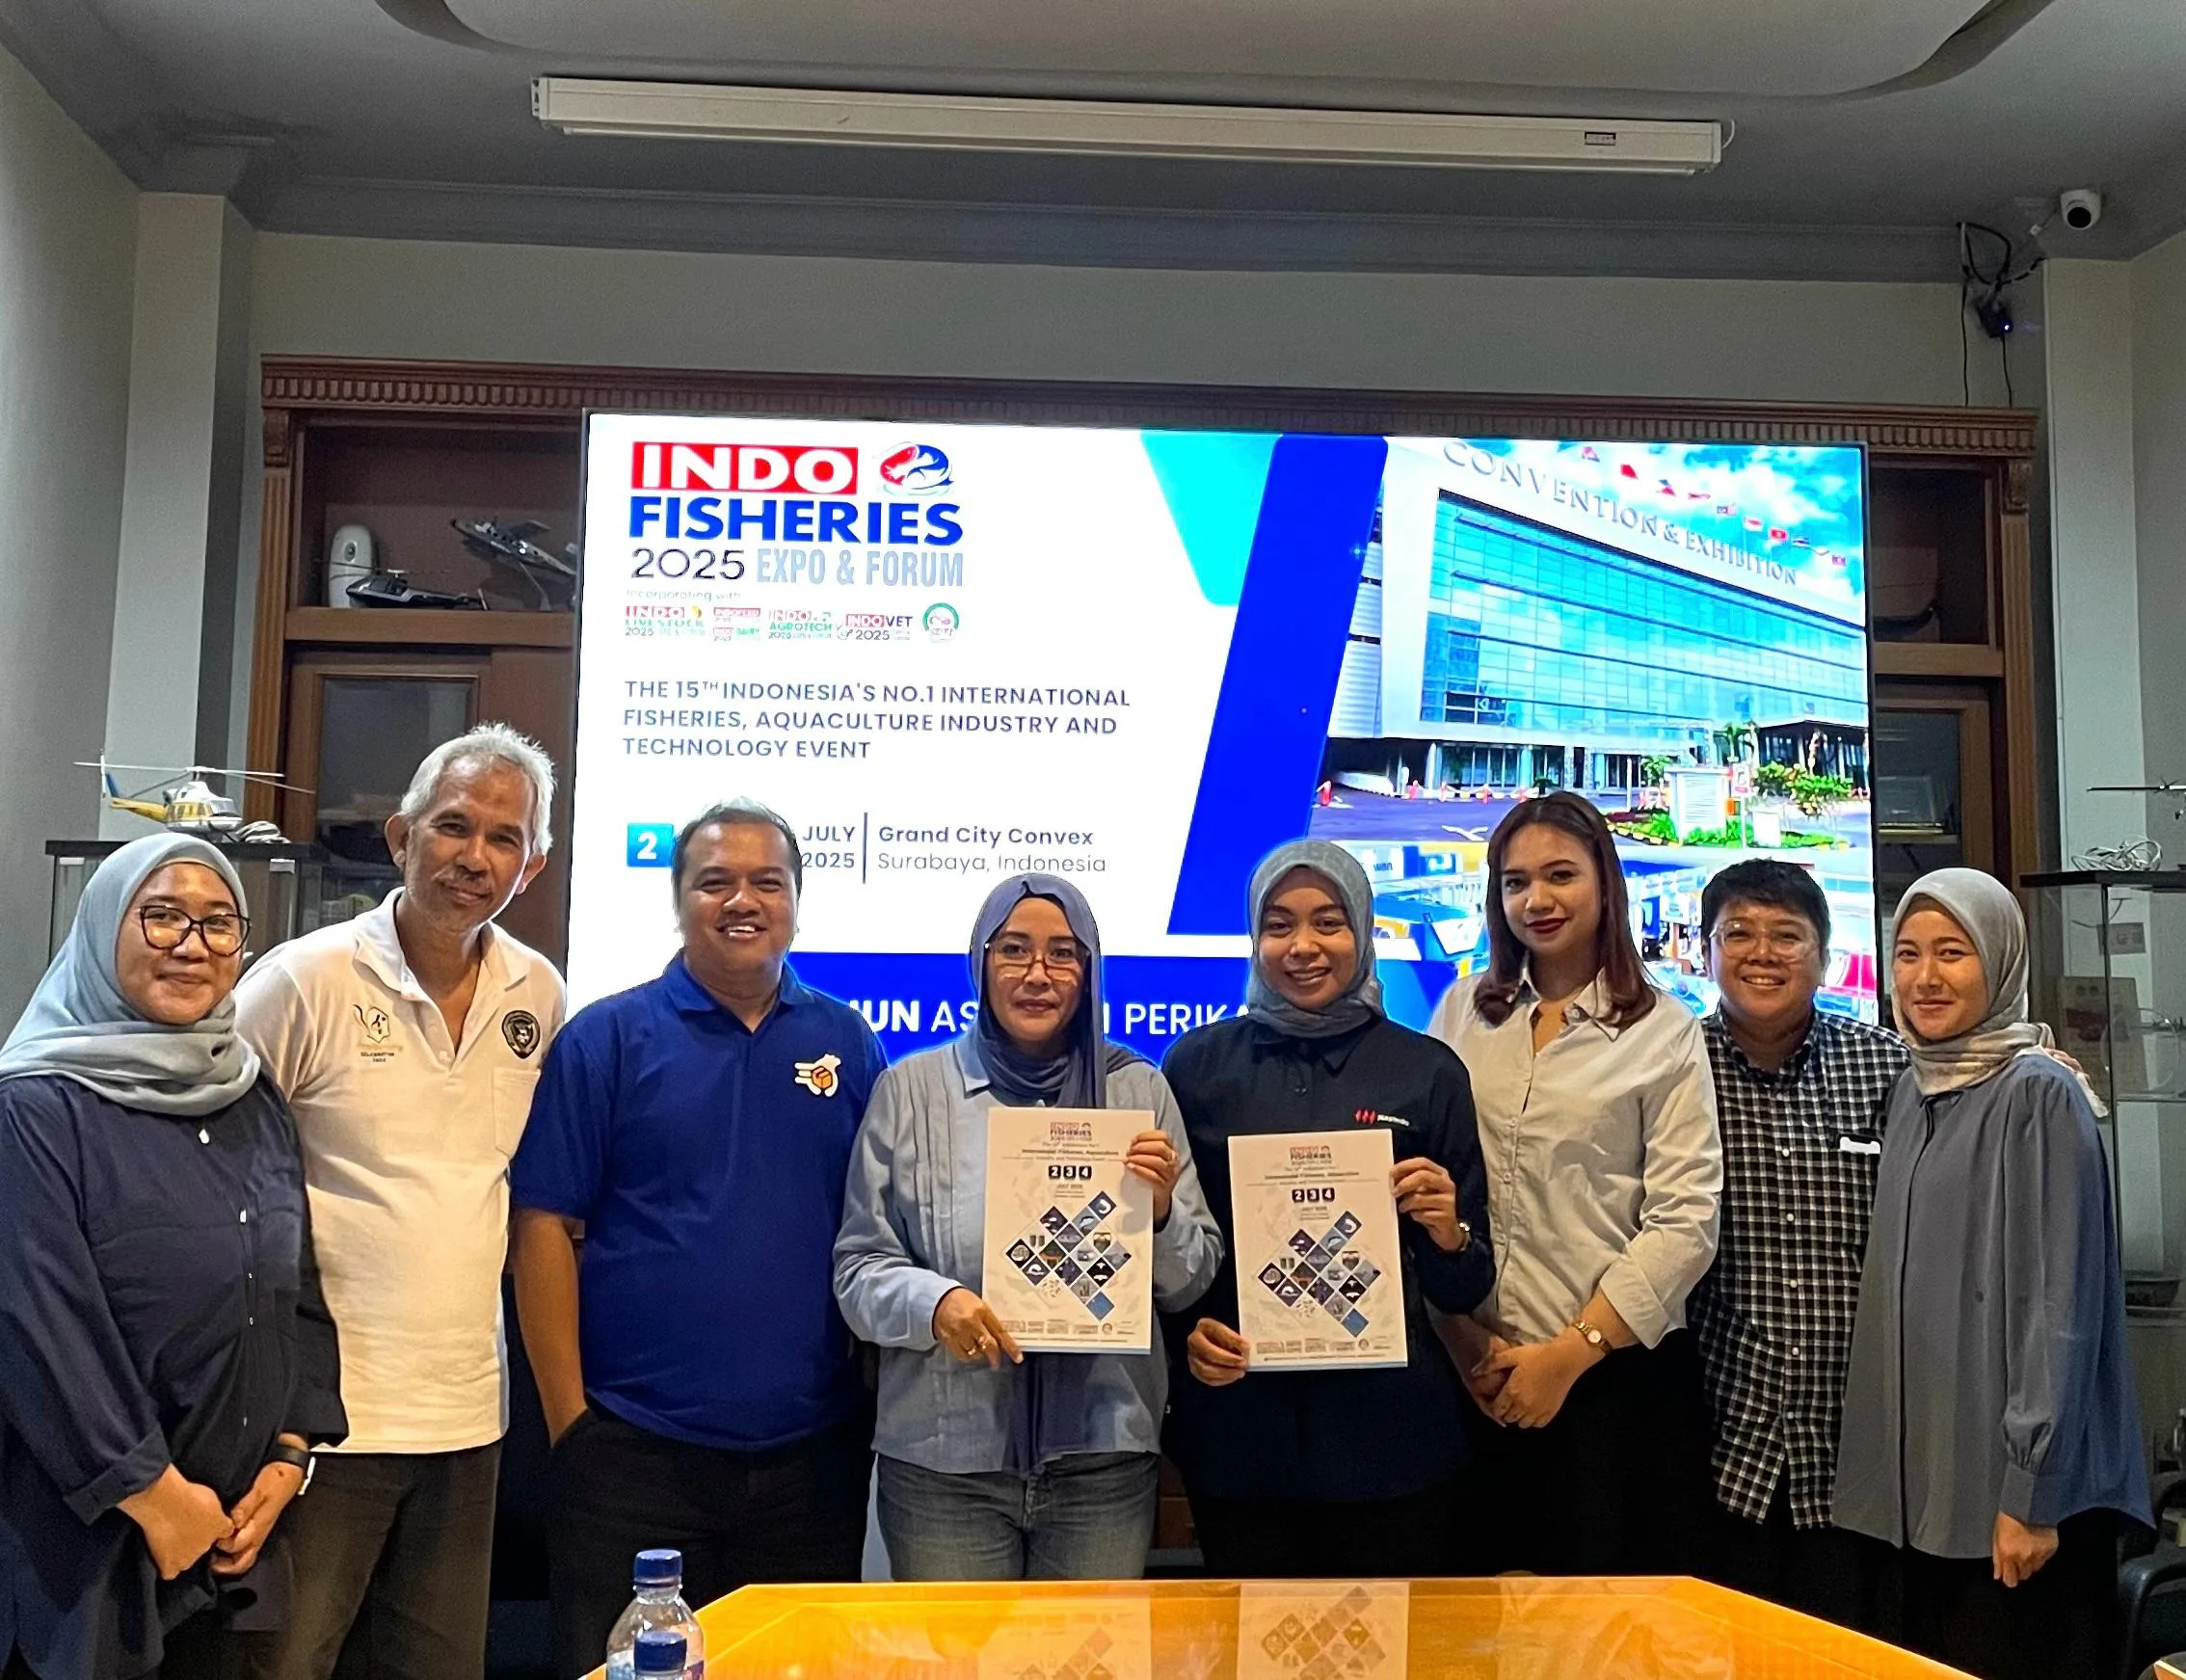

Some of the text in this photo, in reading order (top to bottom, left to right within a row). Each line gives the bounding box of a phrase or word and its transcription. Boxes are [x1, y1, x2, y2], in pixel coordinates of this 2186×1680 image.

[642, 444, 854, 494] INDO
[628, 495, 964, 547] FISHERIES
[1444, 440, 1797, 585] CONVENTION & EXHIBITION
[630, 547, 964, 587] 2025 EXPO & FORUM
[855, 629, 891, 641] 2025
[625, 680, 669, 698] THE
[723, 682, 876, 702] INDONESIA'S
[883, 684, 934, 703] NO.1
[942, 686, 1131, 707] INTERNATIONAL
[624, 709, 1117, 734] FISHERIES, AQUACULTURE INDUSTRY AND
[623, 737, 871, 759] TECHNOLOGY EVENT
[637, 831, 657, 860] 2
[802, 826, 856, 842] JULY
[878, 826, 1094, 849] Grand City Convex
[802, 852, 855, 867] 2025
[878, 853, 1106, 874] Surabaya, Indonesia
